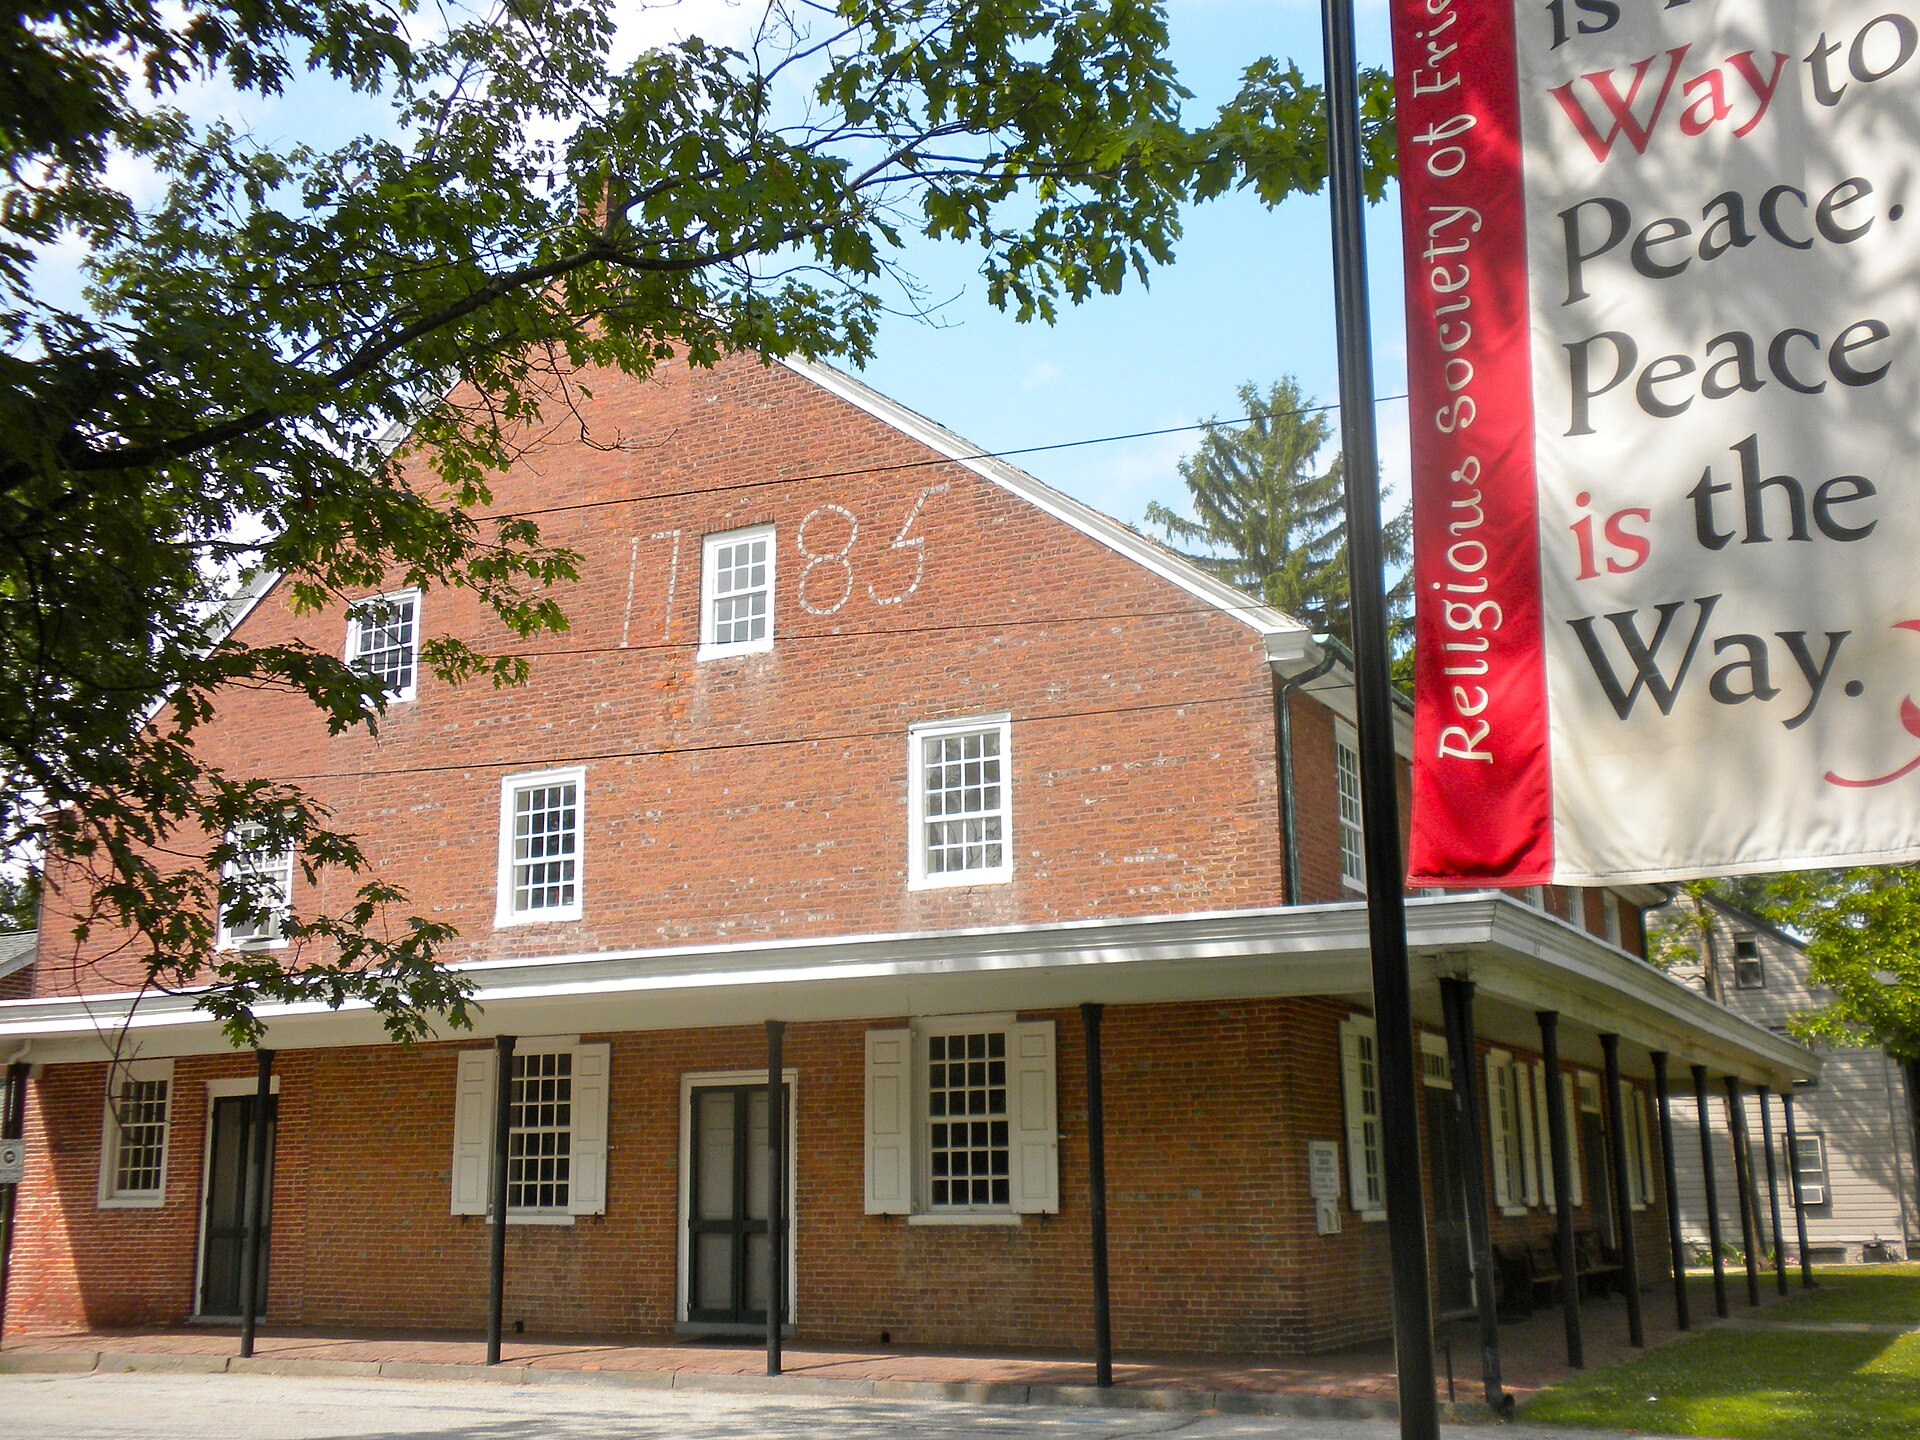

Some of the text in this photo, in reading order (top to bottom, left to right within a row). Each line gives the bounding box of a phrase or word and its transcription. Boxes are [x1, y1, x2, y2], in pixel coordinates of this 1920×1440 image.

[1412, 113, 1478, 177] of
[1547, 13, 1919, 163] Way to
[1556, 177, 1905, 307] Peace.
[1423, 205, 1483, 435] Society
[1562, 318, 1893, 438] Peace
[1569, 432, 1879, 581] is the
[1433, 455, 1503, 765] Religious
[1566, 593, 1865, 731] Way.
